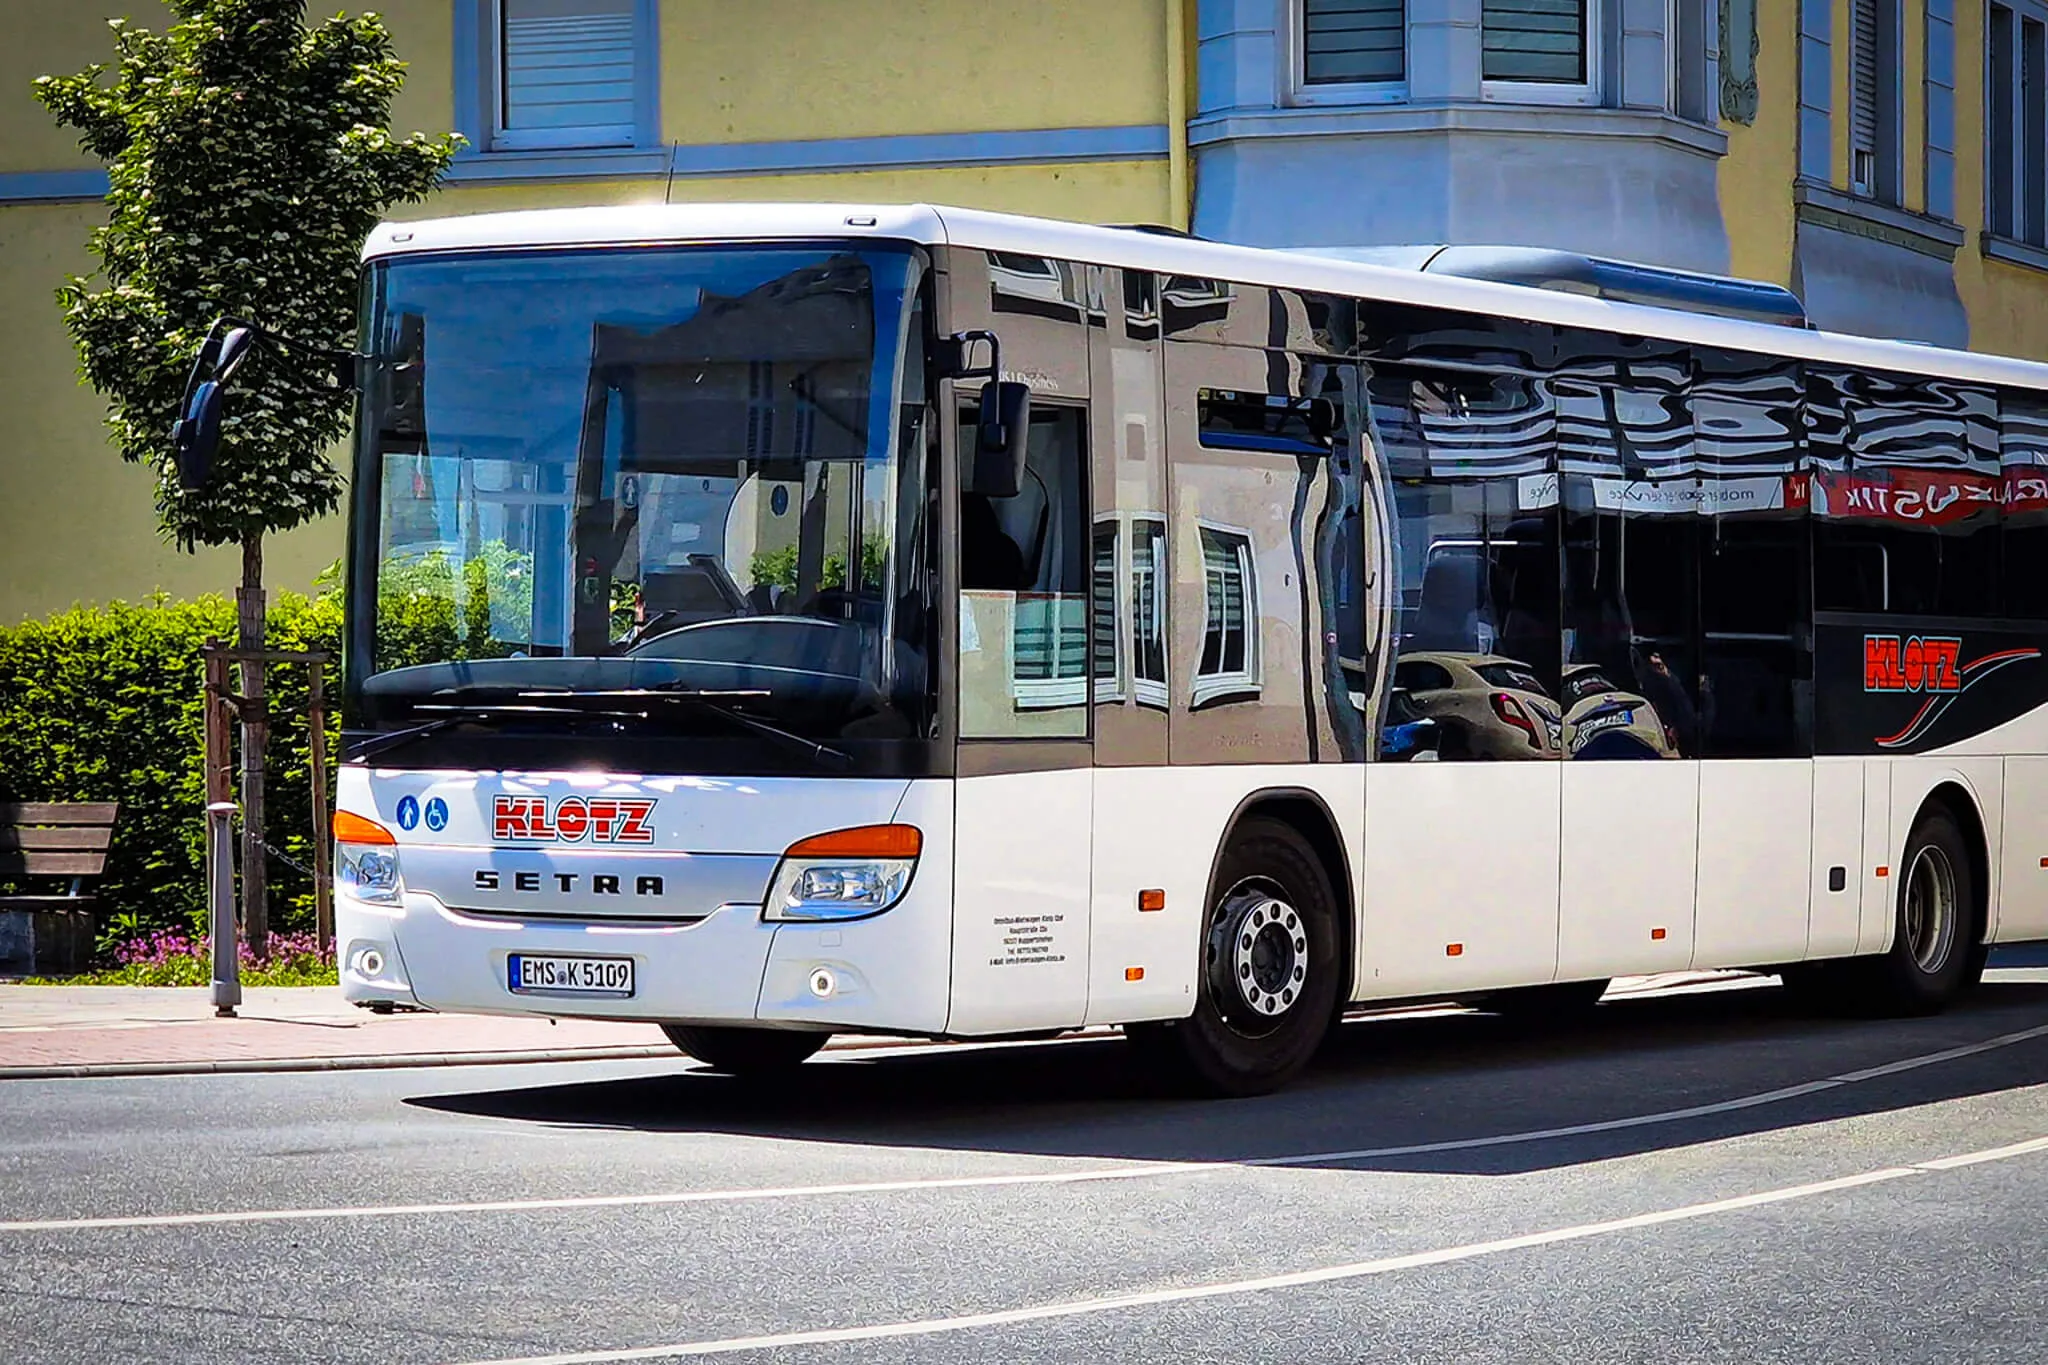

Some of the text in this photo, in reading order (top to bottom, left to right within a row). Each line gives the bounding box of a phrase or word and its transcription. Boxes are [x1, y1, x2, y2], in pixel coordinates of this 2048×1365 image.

[1864, 635, 1962, 692] KLOTZ
[493, 796, 657, 844] KLOTZ
[475, 870, 664, 895] SETRA
[522, 960, 629, 988] EMS K 5109
